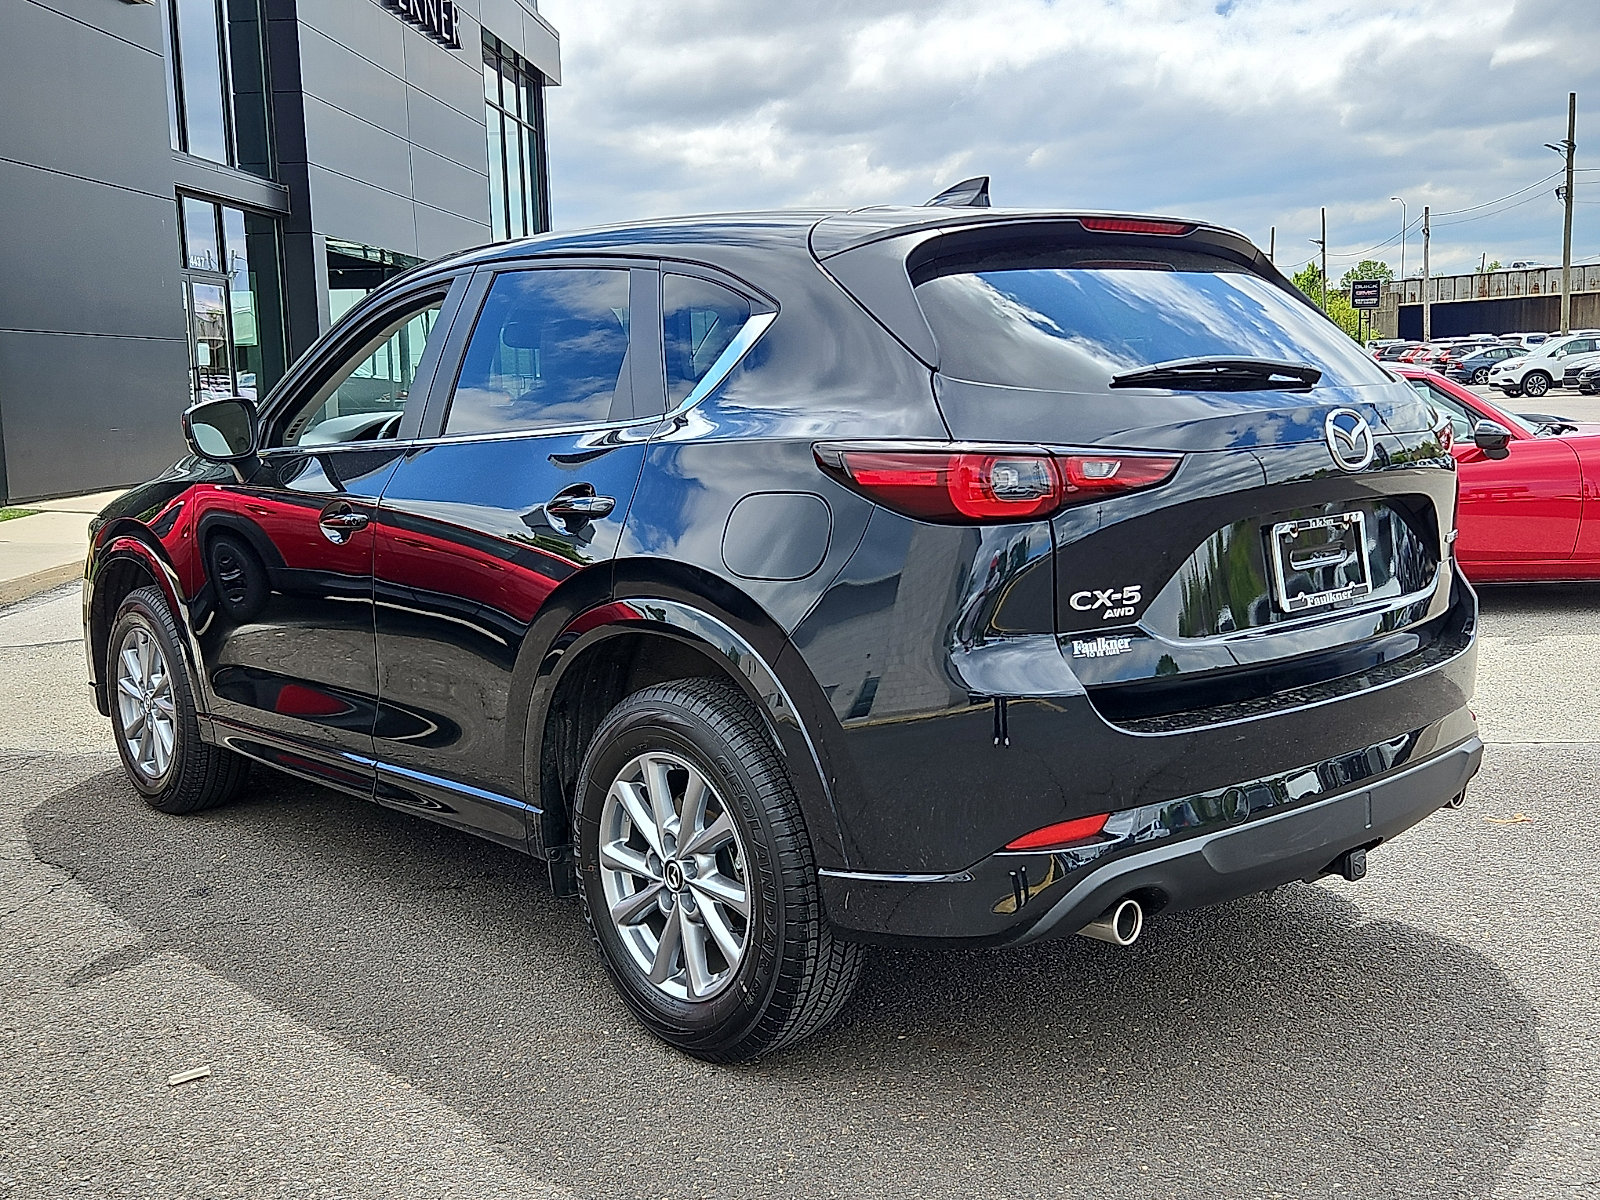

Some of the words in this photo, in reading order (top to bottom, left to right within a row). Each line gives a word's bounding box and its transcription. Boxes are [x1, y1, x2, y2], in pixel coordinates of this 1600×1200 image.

[398, 0, 464, 50] KNER
[1069, 585, 1142, 611] CX-5
[1306, 591, 1353, 606] Faulkner
[1102, 606, 1135, 620] AWD
[1071, 637, 1132, 655] Faulkner
[717, 756, 777, 976] GEOLANDAR
